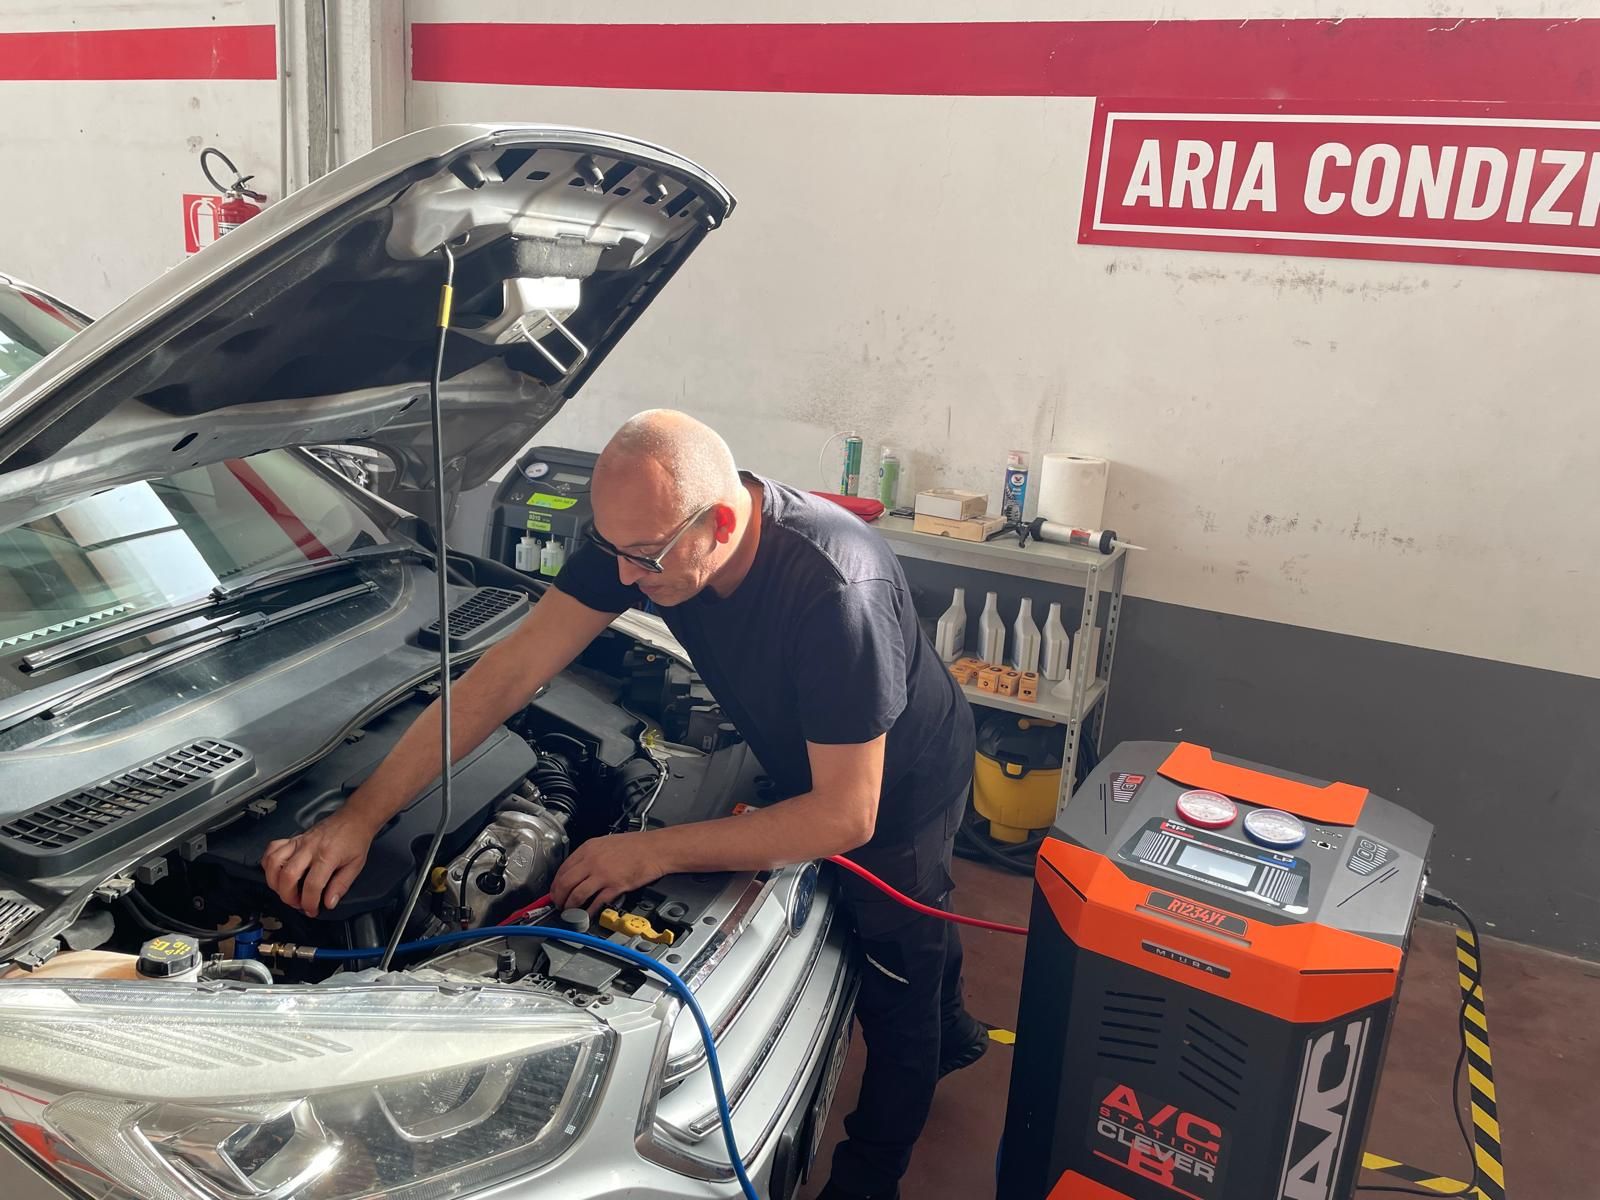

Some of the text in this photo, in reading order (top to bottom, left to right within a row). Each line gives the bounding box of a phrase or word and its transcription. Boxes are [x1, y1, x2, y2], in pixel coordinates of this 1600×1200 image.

[1121, 139, 1600, 227] ARIA CONDIZI
[1273, 854, 1293, 863] LP
[1155, 948, 1214, 973] MIURA
[1100, 1106, 1218, 1164] STATION
[1101, 1084, 1222, 1152] A/C
[1097, 1119, 1215, 1183] CLEVER
